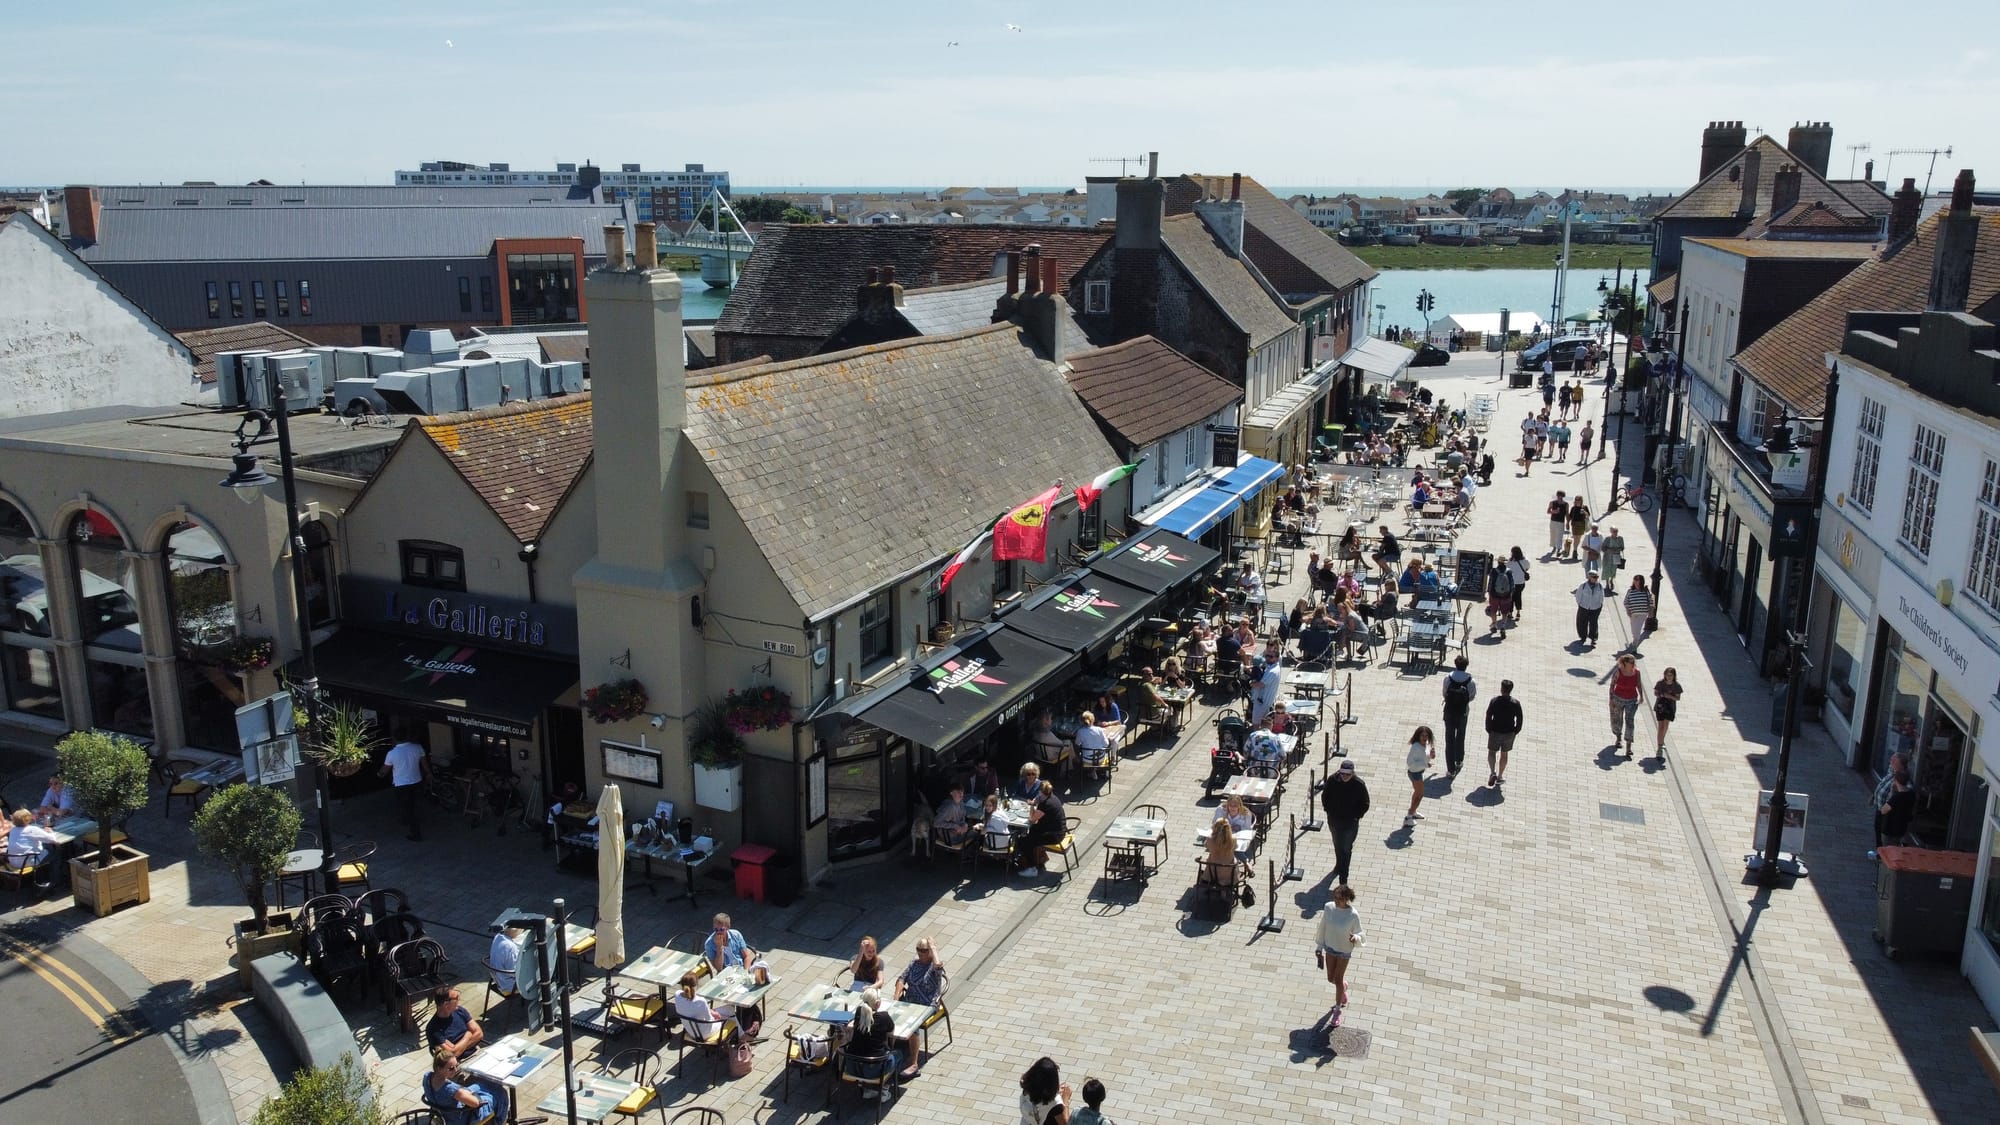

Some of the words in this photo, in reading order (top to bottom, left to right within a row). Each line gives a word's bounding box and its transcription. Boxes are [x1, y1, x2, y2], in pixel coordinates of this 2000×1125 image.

[385, 591, 419, 624] La
[428, 598, 544, 646] Galleria
[1899, 596, 1910, 617] The
[1910, 607, 1942, 648] Children's
[1943, 637, 1968, 676] Society
[763, 641, 777, 650] NEW
[780, 643, 795, 654] ROAD
[425, 660, 477, 675] Galleria
[927, 678, 947, 695] La
[942, 657, 986, 684] Galleria
